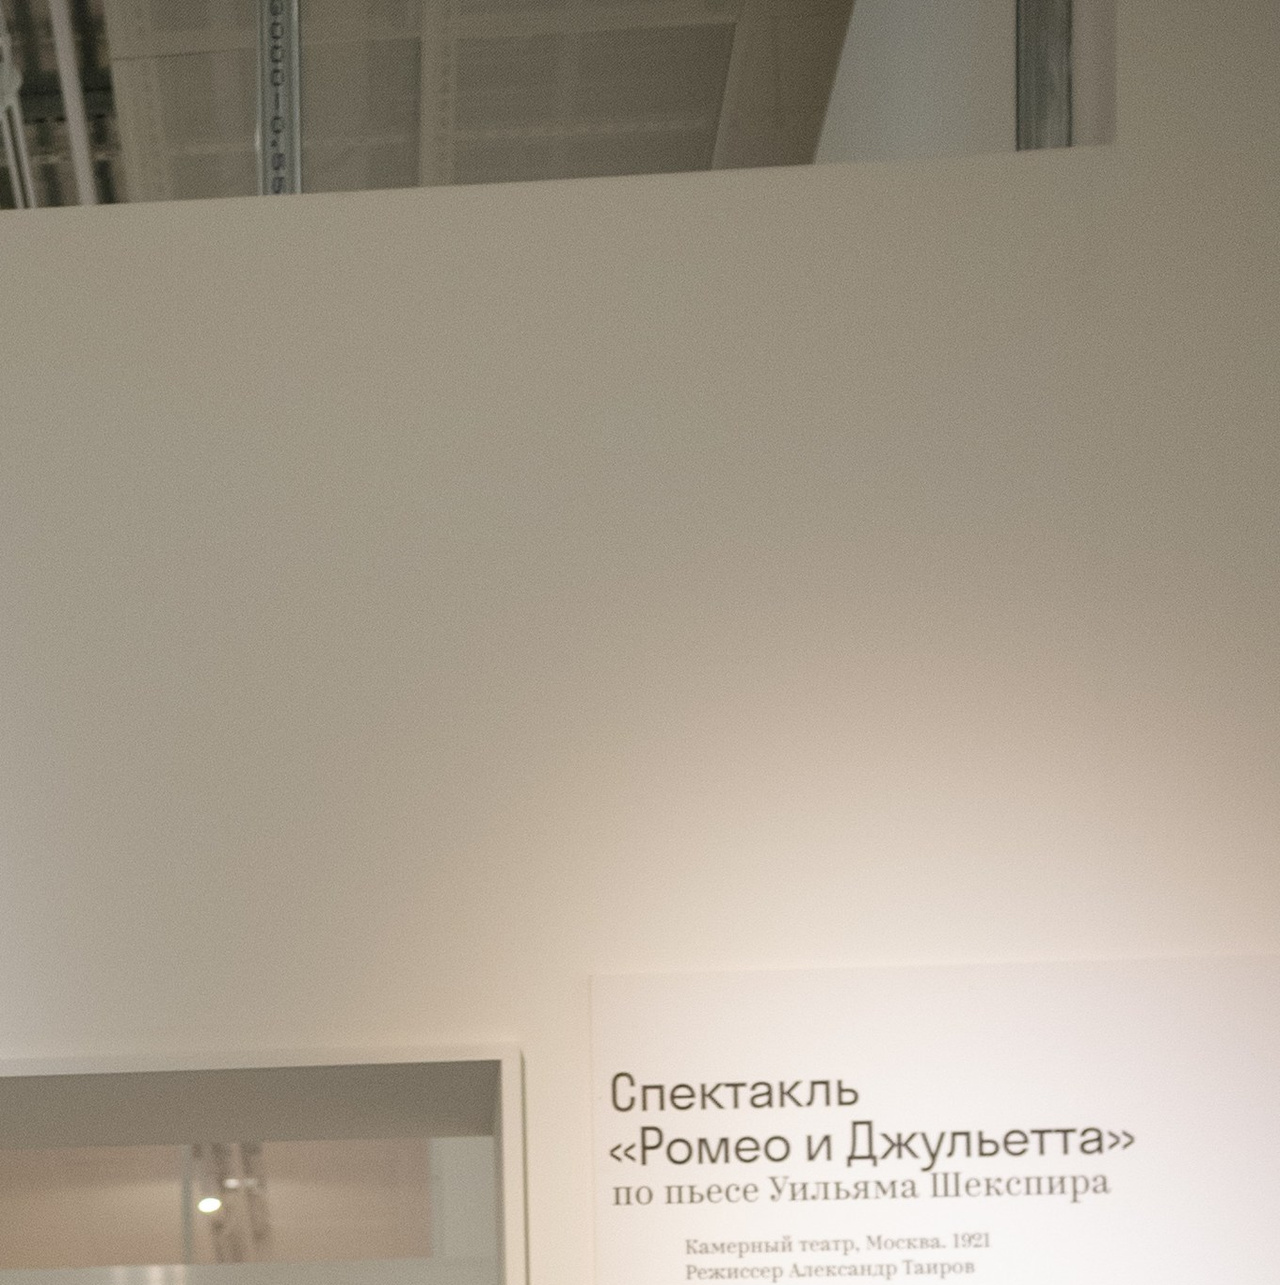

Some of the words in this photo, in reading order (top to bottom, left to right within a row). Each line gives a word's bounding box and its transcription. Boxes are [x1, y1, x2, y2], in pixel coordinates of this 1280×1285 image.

[611, 1068, 859, 1111] Спектакль
[610, 1125, 791, 1166] «Ромео
[807, 1135, 832, 1161] и
[847, 1117, 1134, 1169] Джульетта»
[614, 1186, 653, 1205] по
[666, 1183, 759, 1204] пьесе
[769, 1172, 919, 1201] Уильяма
[930, 1167, 1112, 1204] Шекспира
[685, 1234, 793, 1259] Камерный
[799, 1238, 860, 1257] театр,
[953, 1229, 990, 1248] 1921
[686, 1261, 784, 1284] Режиссер
[790, 1259, 898, 1282] Александр
[903, 1257, 975, 1280] Таиров
